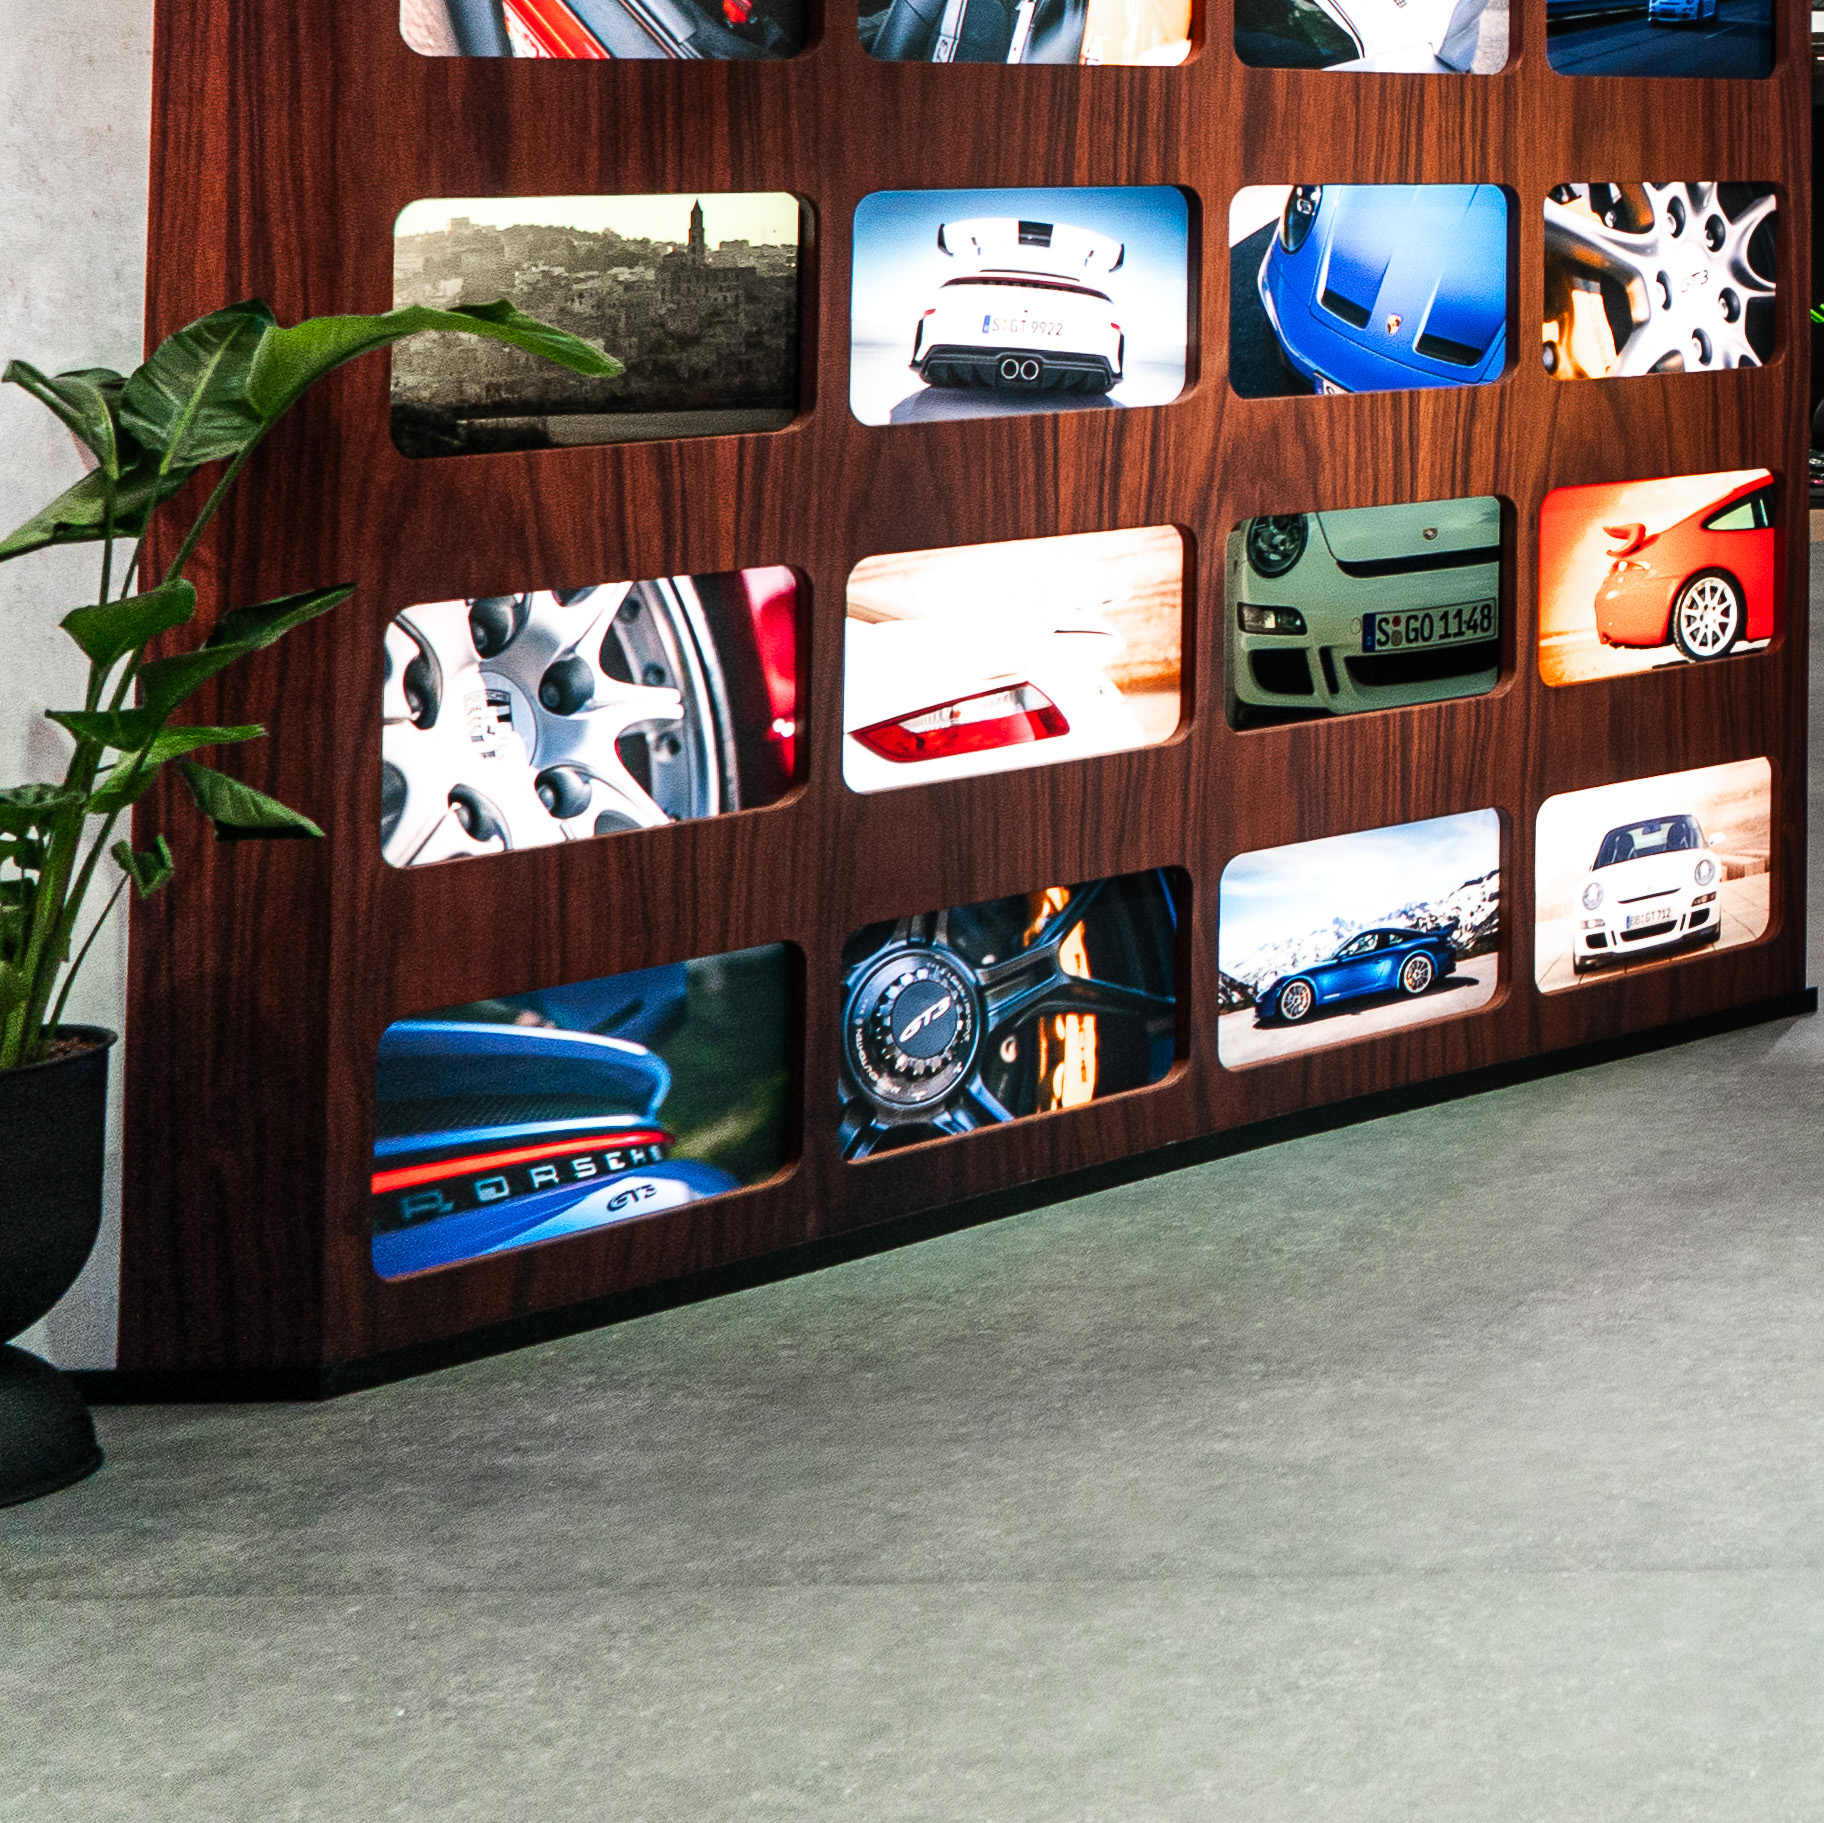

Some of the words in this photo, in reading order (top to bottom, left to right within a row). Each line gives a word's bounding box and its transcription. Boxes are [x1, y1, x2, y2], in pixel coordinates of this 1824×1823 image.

[1376, 617, 1391, 647] S
[1438, 603, 1493, 641] 1148
[899, 995, 952, 1043] GT3
[606, 1182, 658, 1213] GT3
